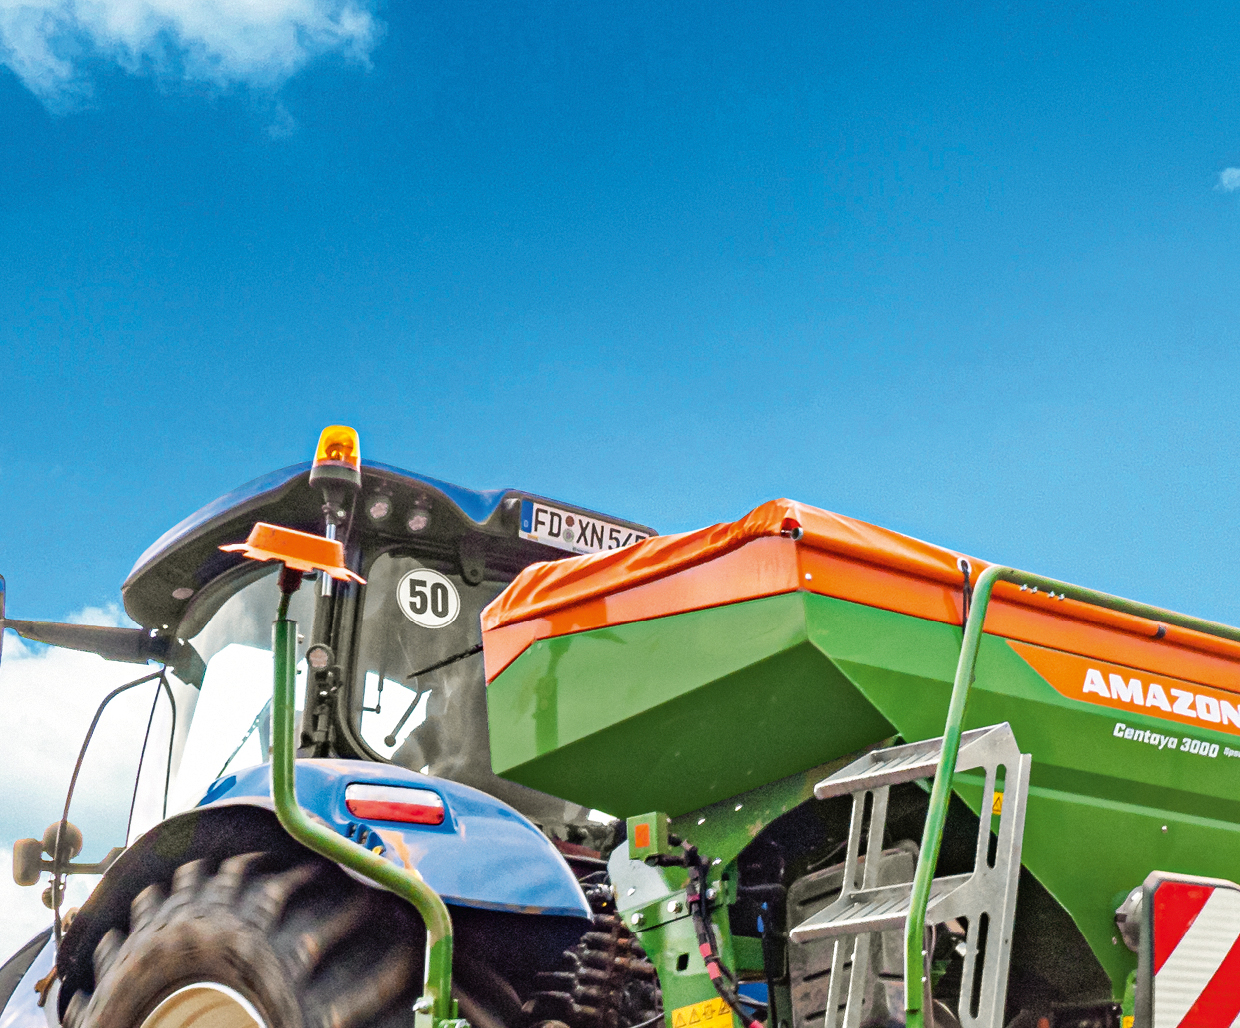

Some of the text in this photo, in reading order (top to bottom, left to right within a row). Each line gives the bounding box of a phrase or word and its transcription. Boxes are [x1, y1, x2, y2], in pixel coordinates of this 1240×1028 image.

[534, 507, 562, 538] FD
[576, 518, 605, 550] XN
[409, 578, 450, 619] 50
[1113, 722, 1178, 750] Centaya
[1180, 737, 1220, 758] 3000
